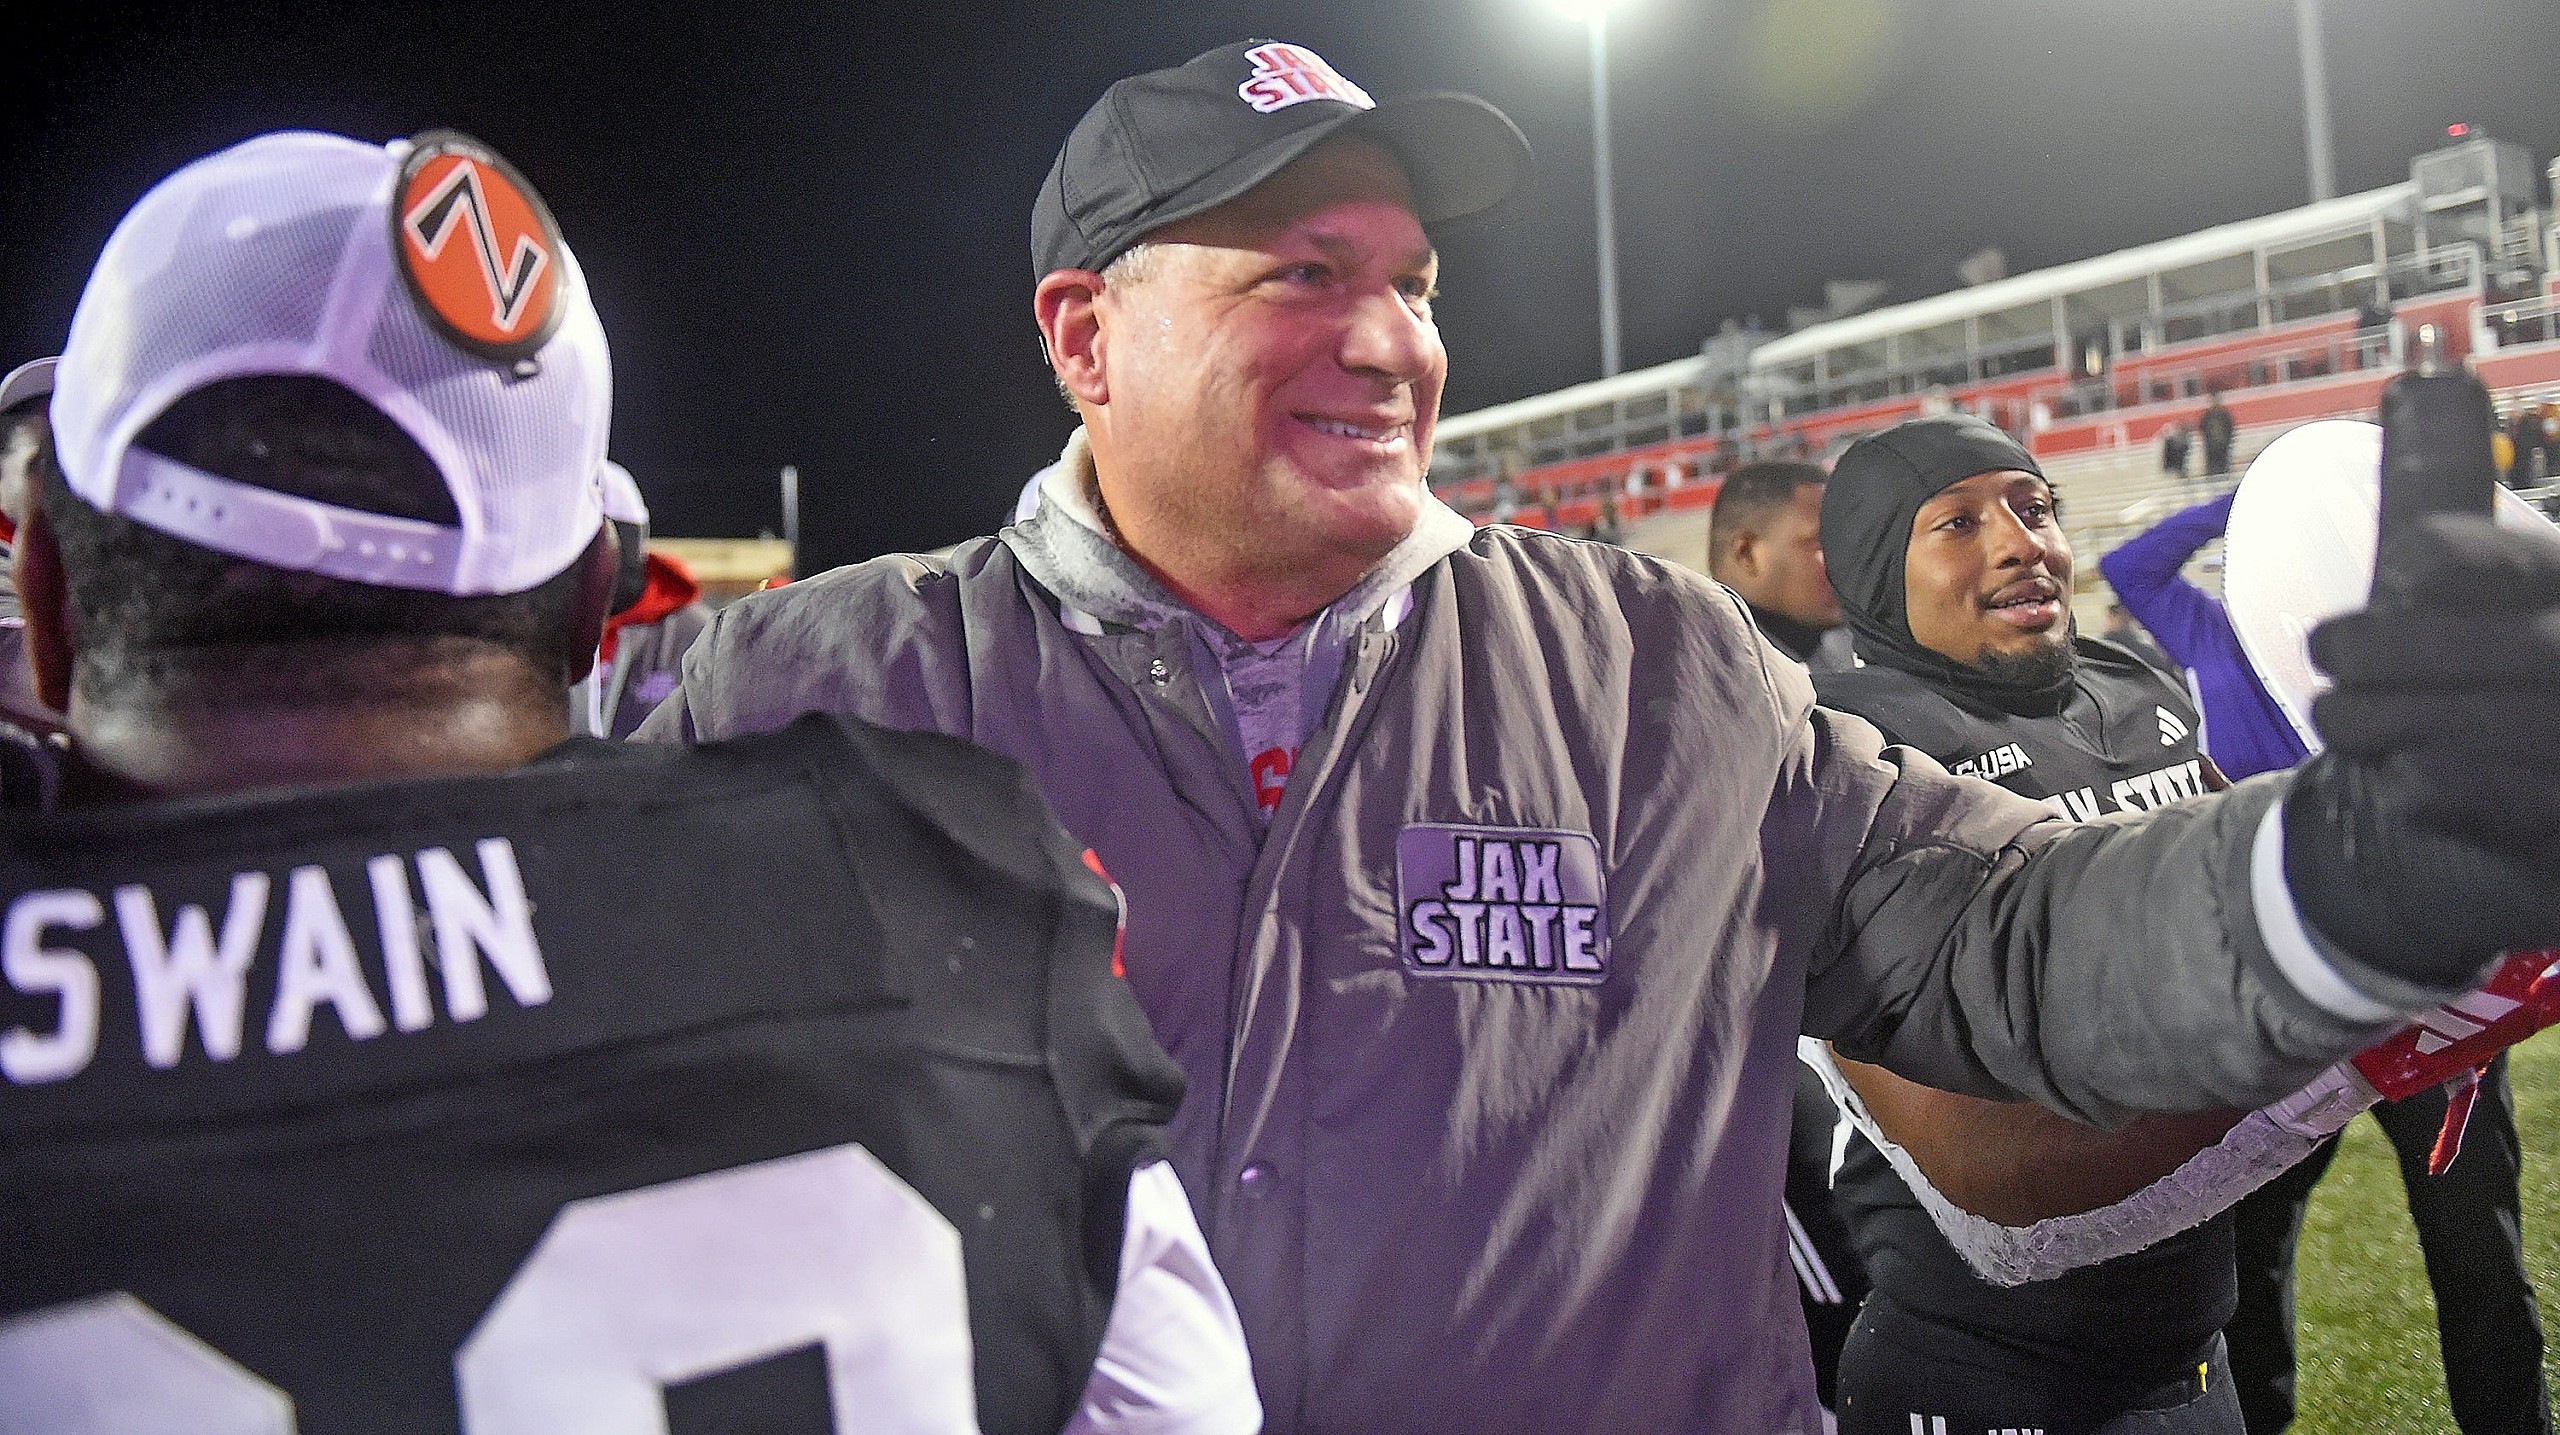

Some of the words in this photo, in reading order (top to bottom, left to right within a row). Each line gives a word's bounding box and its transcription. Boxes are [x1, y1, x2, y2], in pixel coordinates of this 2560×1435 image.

[1242, 69, 1374, 108] STA
[1444, 837, 1563, 903] JAX
[0, 836, 554, 1085] SWAIN
[1411, 901, 1601, 970] STATE
